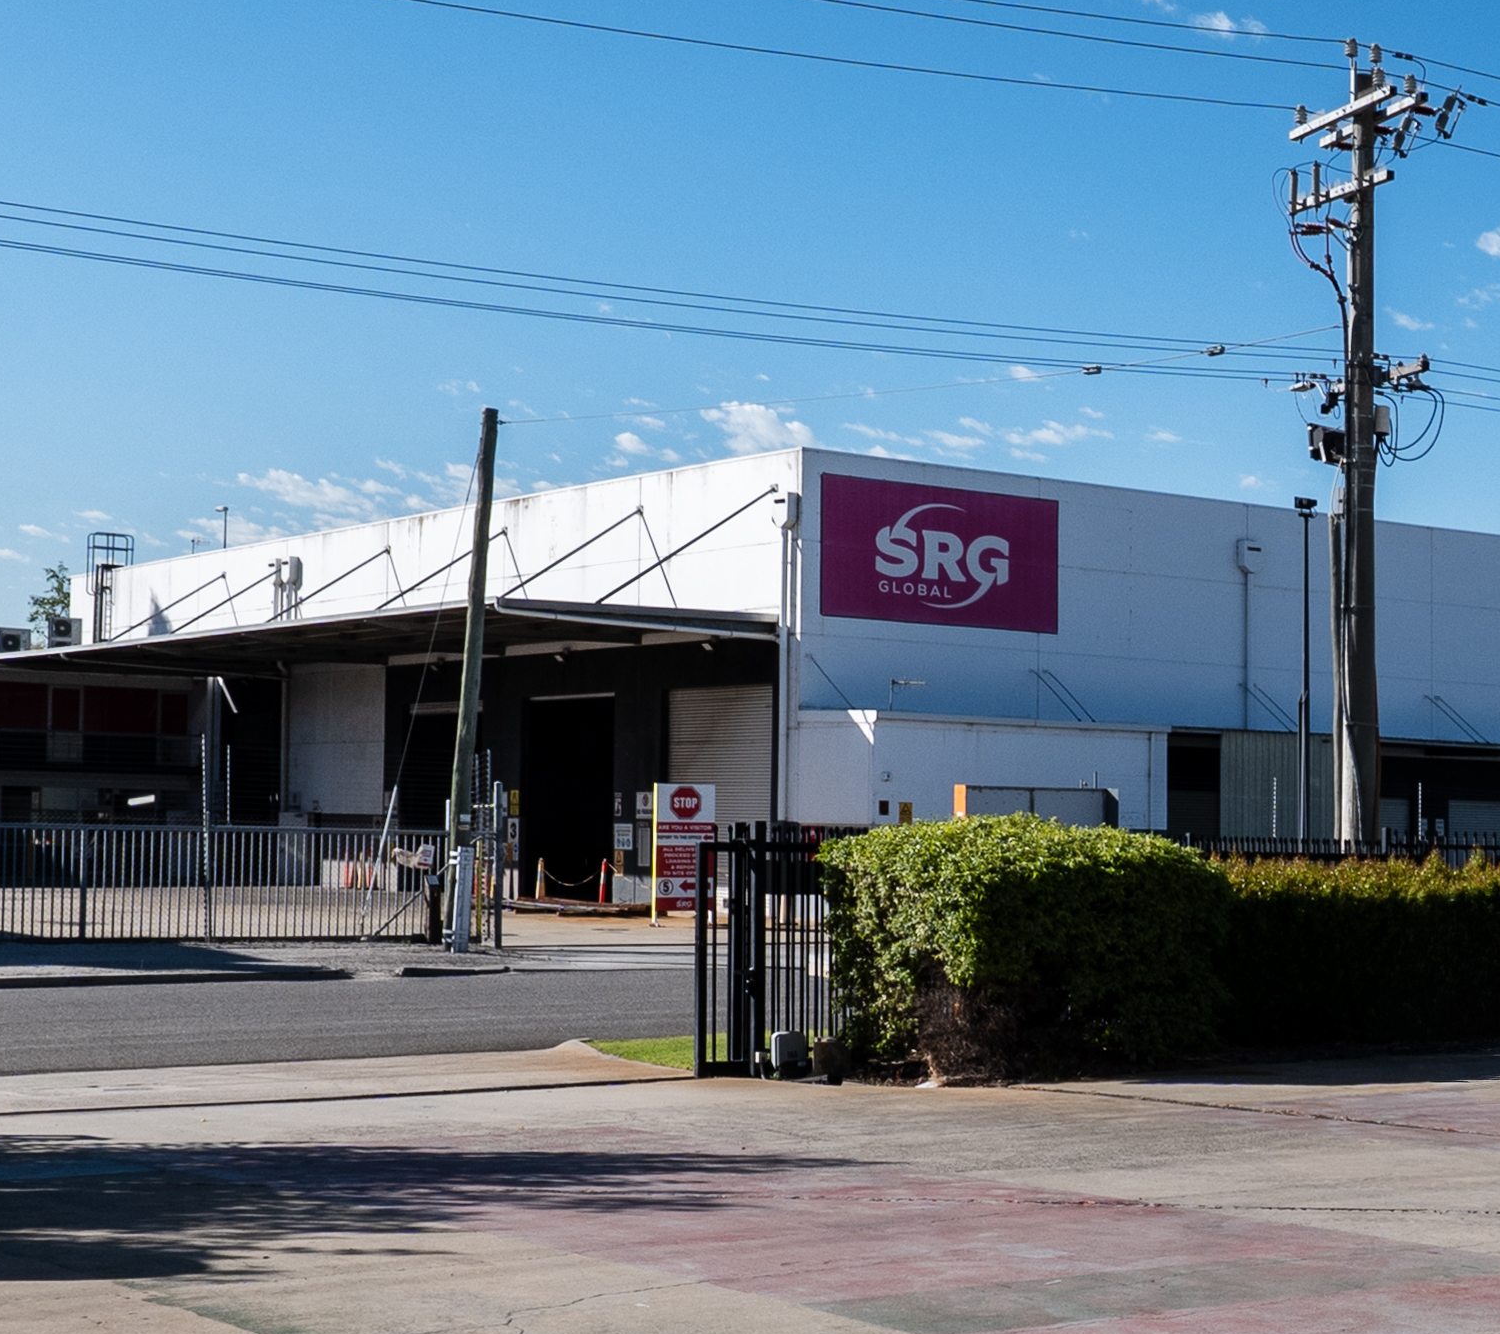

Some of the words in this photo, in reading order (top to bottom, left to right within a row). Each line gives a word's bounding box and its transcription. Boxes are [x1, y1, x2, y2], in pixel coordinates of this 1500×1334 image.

[875, 522, 1010, 587] SRG
[879, 580, 953, 598] GLOBAL
[673, 797, 698, 808] STOP
[510, 822, 517, 839] 3
[663, 881, 670, 893] 5
